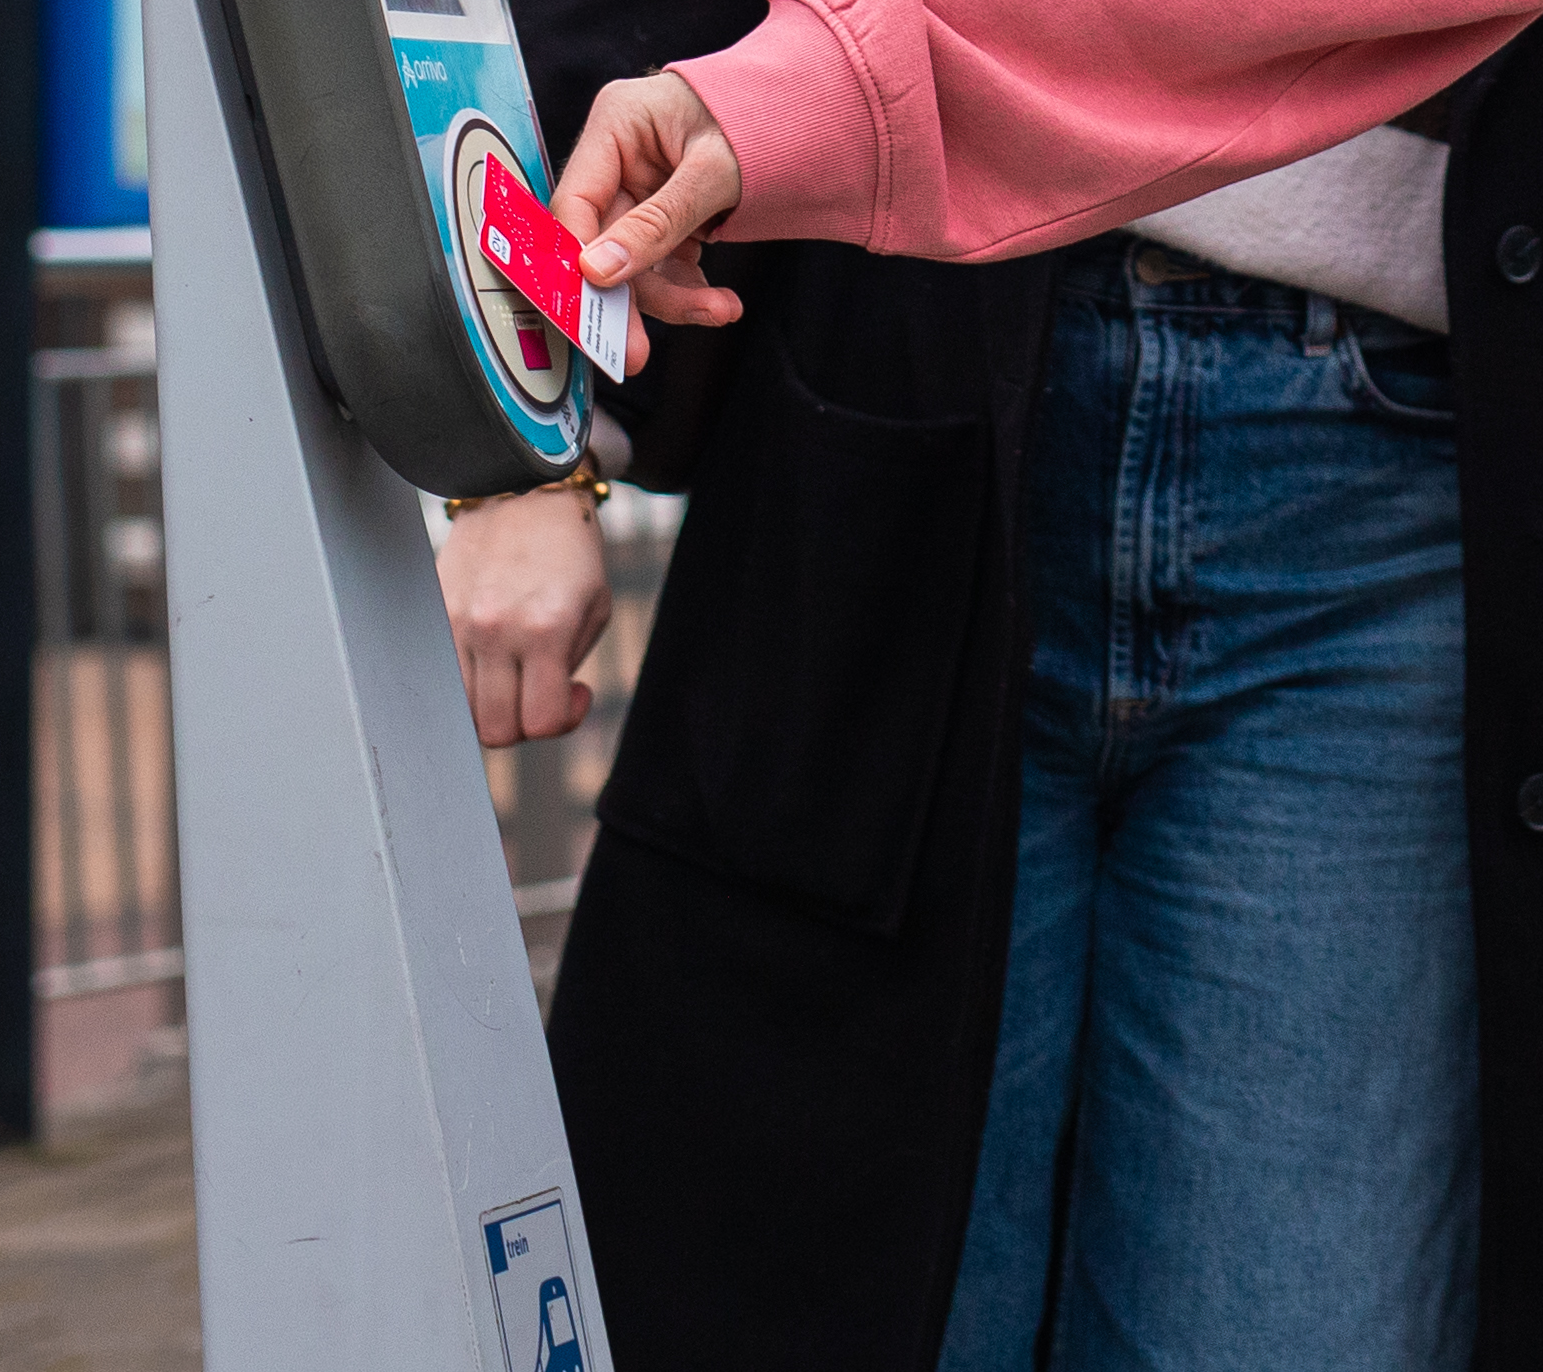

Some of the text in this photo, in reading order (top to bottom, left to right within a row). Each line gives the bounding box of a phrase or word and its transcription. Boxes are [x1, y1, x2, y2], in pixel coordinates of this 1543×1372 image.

[413, 54, 448, 82] arriva
[491, 229, 501, 253] OV
[506, 1232, 530, 1258] trein
